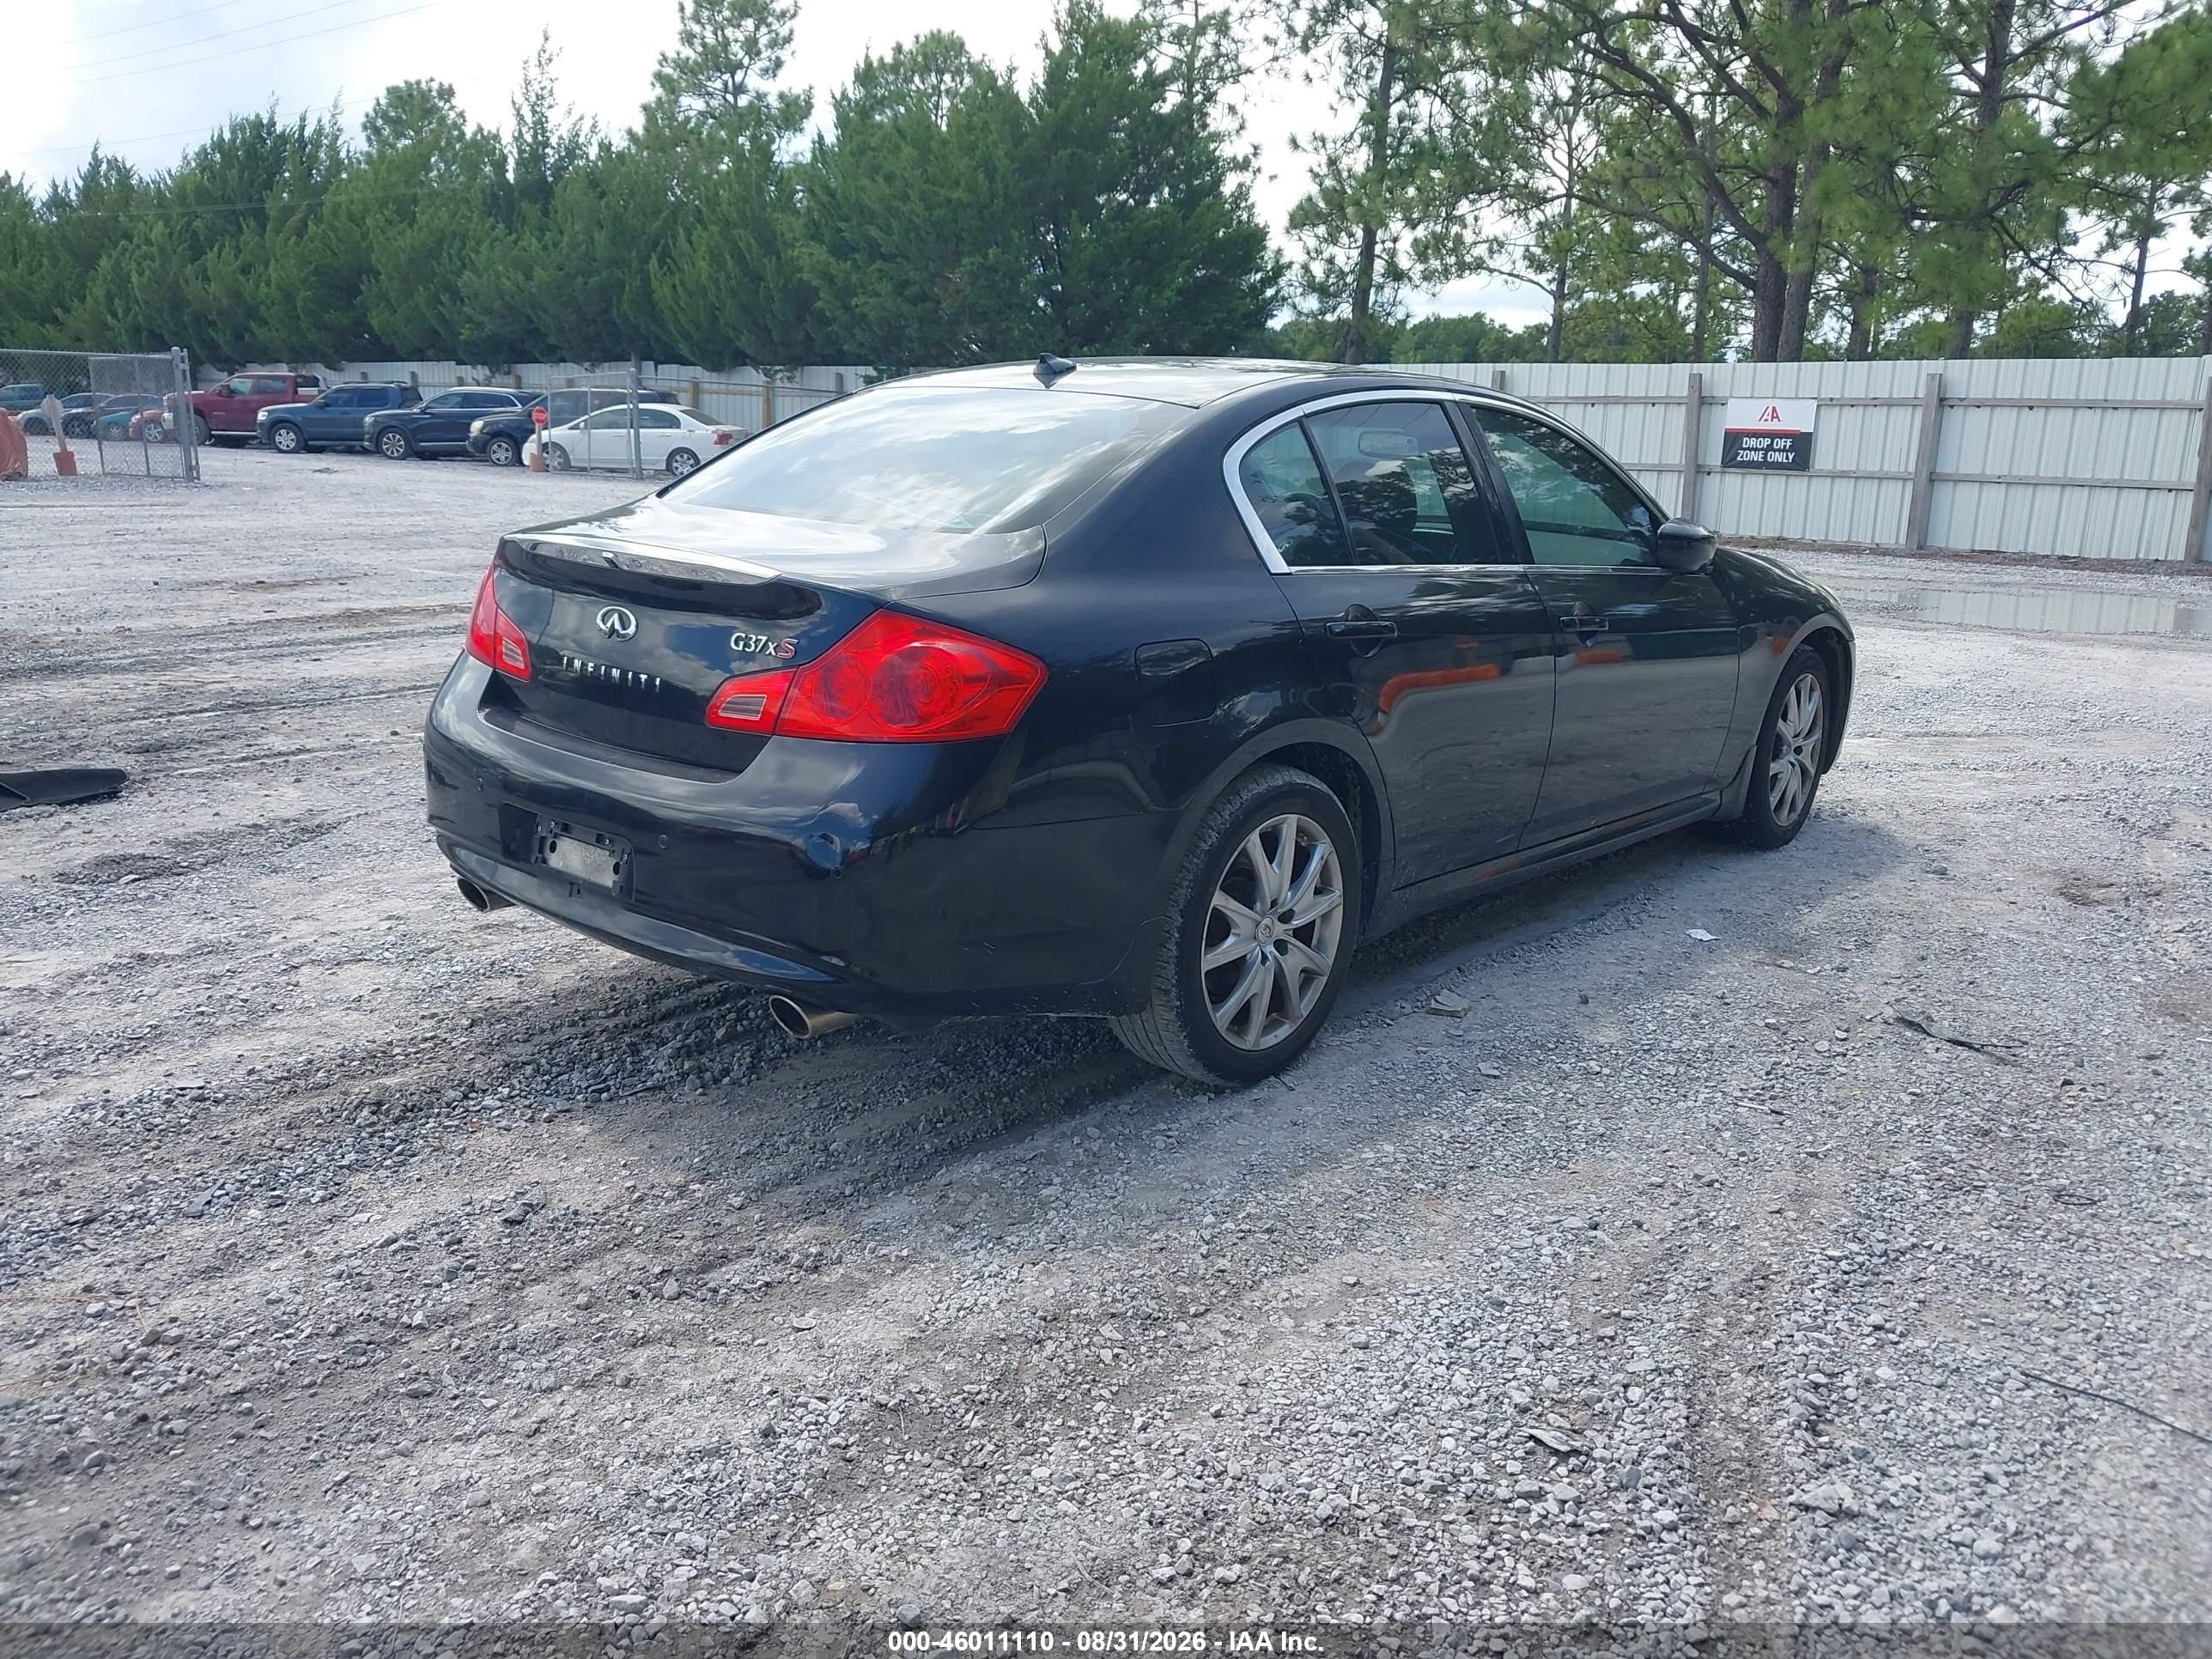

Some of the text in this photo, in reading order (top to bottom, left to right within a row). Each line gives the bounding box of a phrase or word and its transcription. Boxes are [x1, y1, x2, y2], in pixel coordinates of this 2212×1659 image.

[1742, 437, 1793, 450] DROP OFF
[1736, 450, 1796, 463] ZONE ONLY
[562, 656, 660, 692] INFINITI
